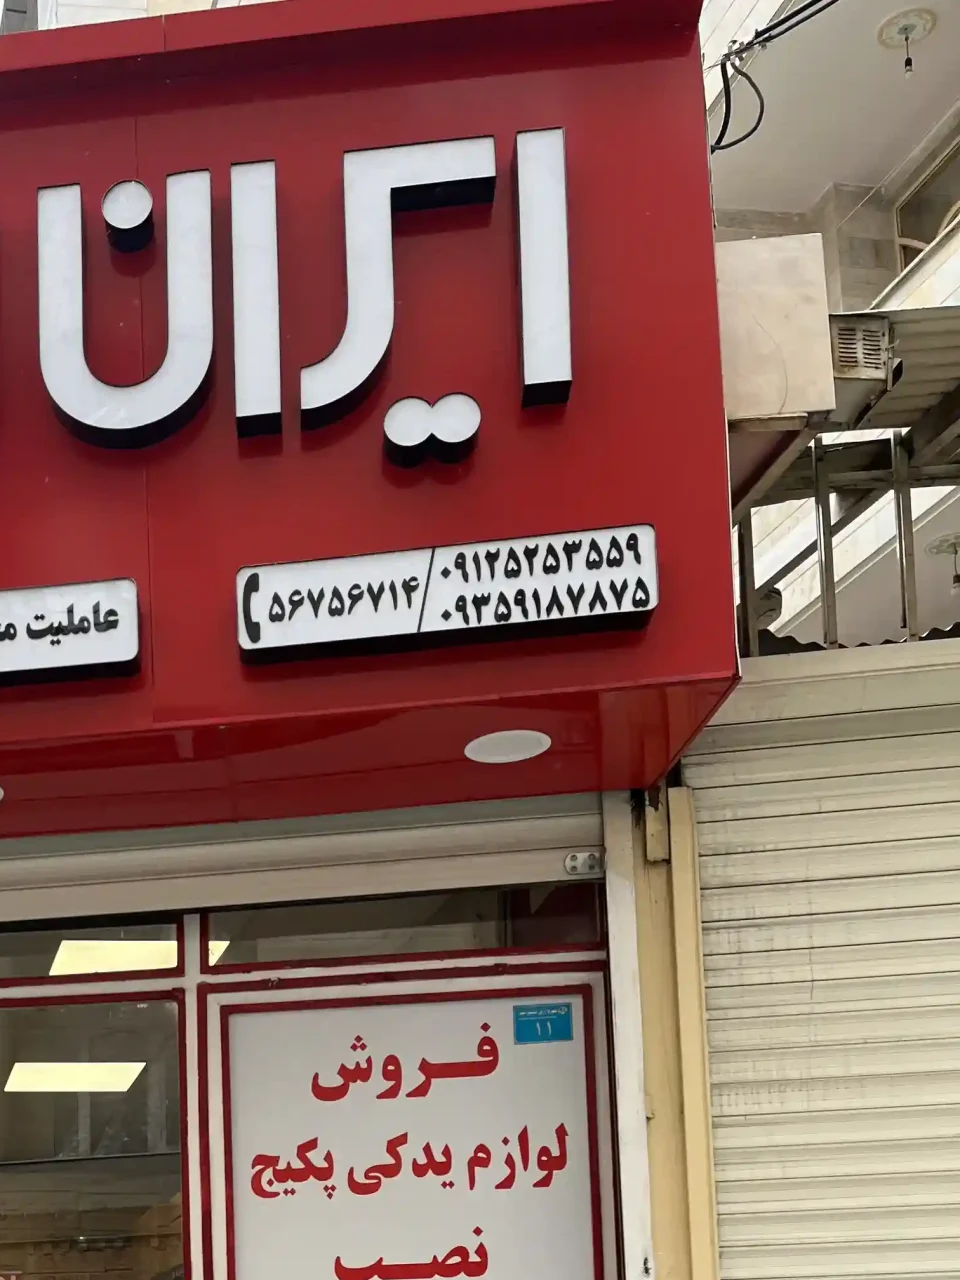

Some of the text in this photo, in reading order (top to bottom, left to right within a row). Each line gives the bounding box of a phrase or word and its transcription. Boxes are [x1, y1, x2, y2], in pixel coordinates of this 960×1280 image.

[38, 127, 572, 446] ایران
[440, 532, 642, 584] ۰۹۱۲۵۲۵۳۵۵۹
[25, 601, 120, 646] عاملیت
[268, 575, 420, 623] ۵۶۷۵۶۷۱۴
[440, 576, 651, 626] ۰۹۳۵۹۱۸۷۸۷۵
[311, 1022, 500, 1102] فروش
[250, 1122, 569, 1200] لوازم یدکی پکیج
